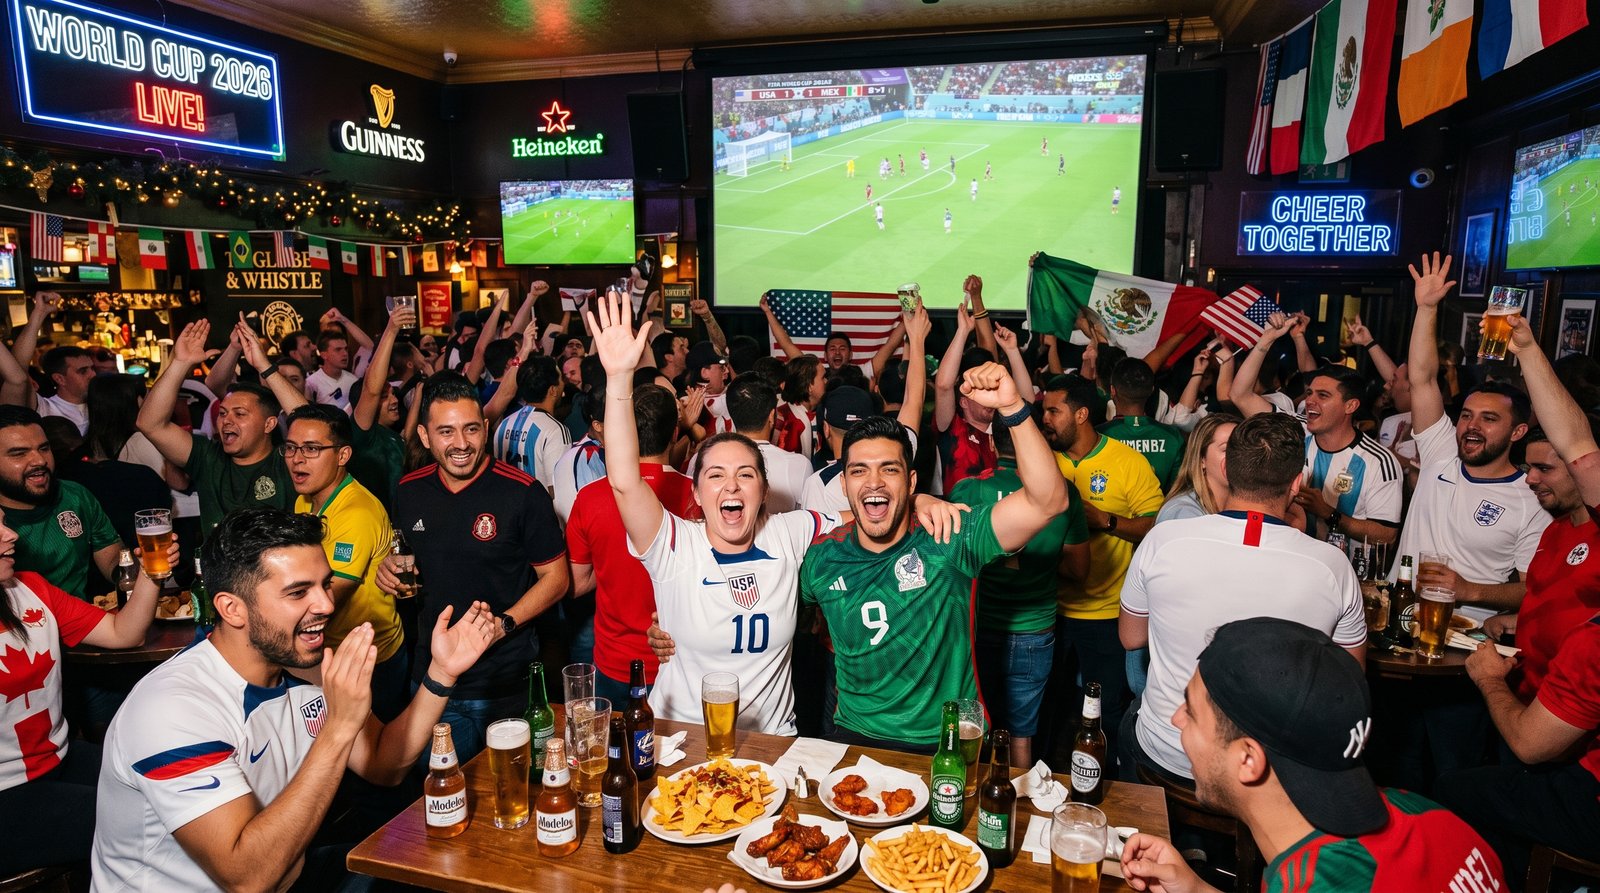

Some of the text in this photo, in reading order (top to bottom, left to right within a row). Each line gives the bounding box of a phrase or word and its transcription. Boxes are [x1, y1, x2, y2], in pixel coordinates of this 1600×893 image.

[26, 5, 273, 100] WORLD CUP 2026
[759, 91, 777, 99] USA
[784, 90, 789, 98] 1
[808, 89, 813, 97] 1
[820, 88, 840, 97] MEX
[135, 82, 206, 133] LIVE!
[341, 120, 426, 163] GUINNESS
[512, 136, 603, 158] Heineken
[1271, 195, 1366, 223] CHEER
[1243, 224, 1391, 252] TOGETHER
[252, 250, 312, 269] GLBE
[226, 271, 323, 290] & WHISTLE
[731, 575, 756, 592] USA
[731, 613, 770, 654] 10
[861, 600, 889, 646] 9
[302, 698, 324, 719] USA
[431, 796, 464, 811] Modelo
[538, 815, 570, 830] Modelo
